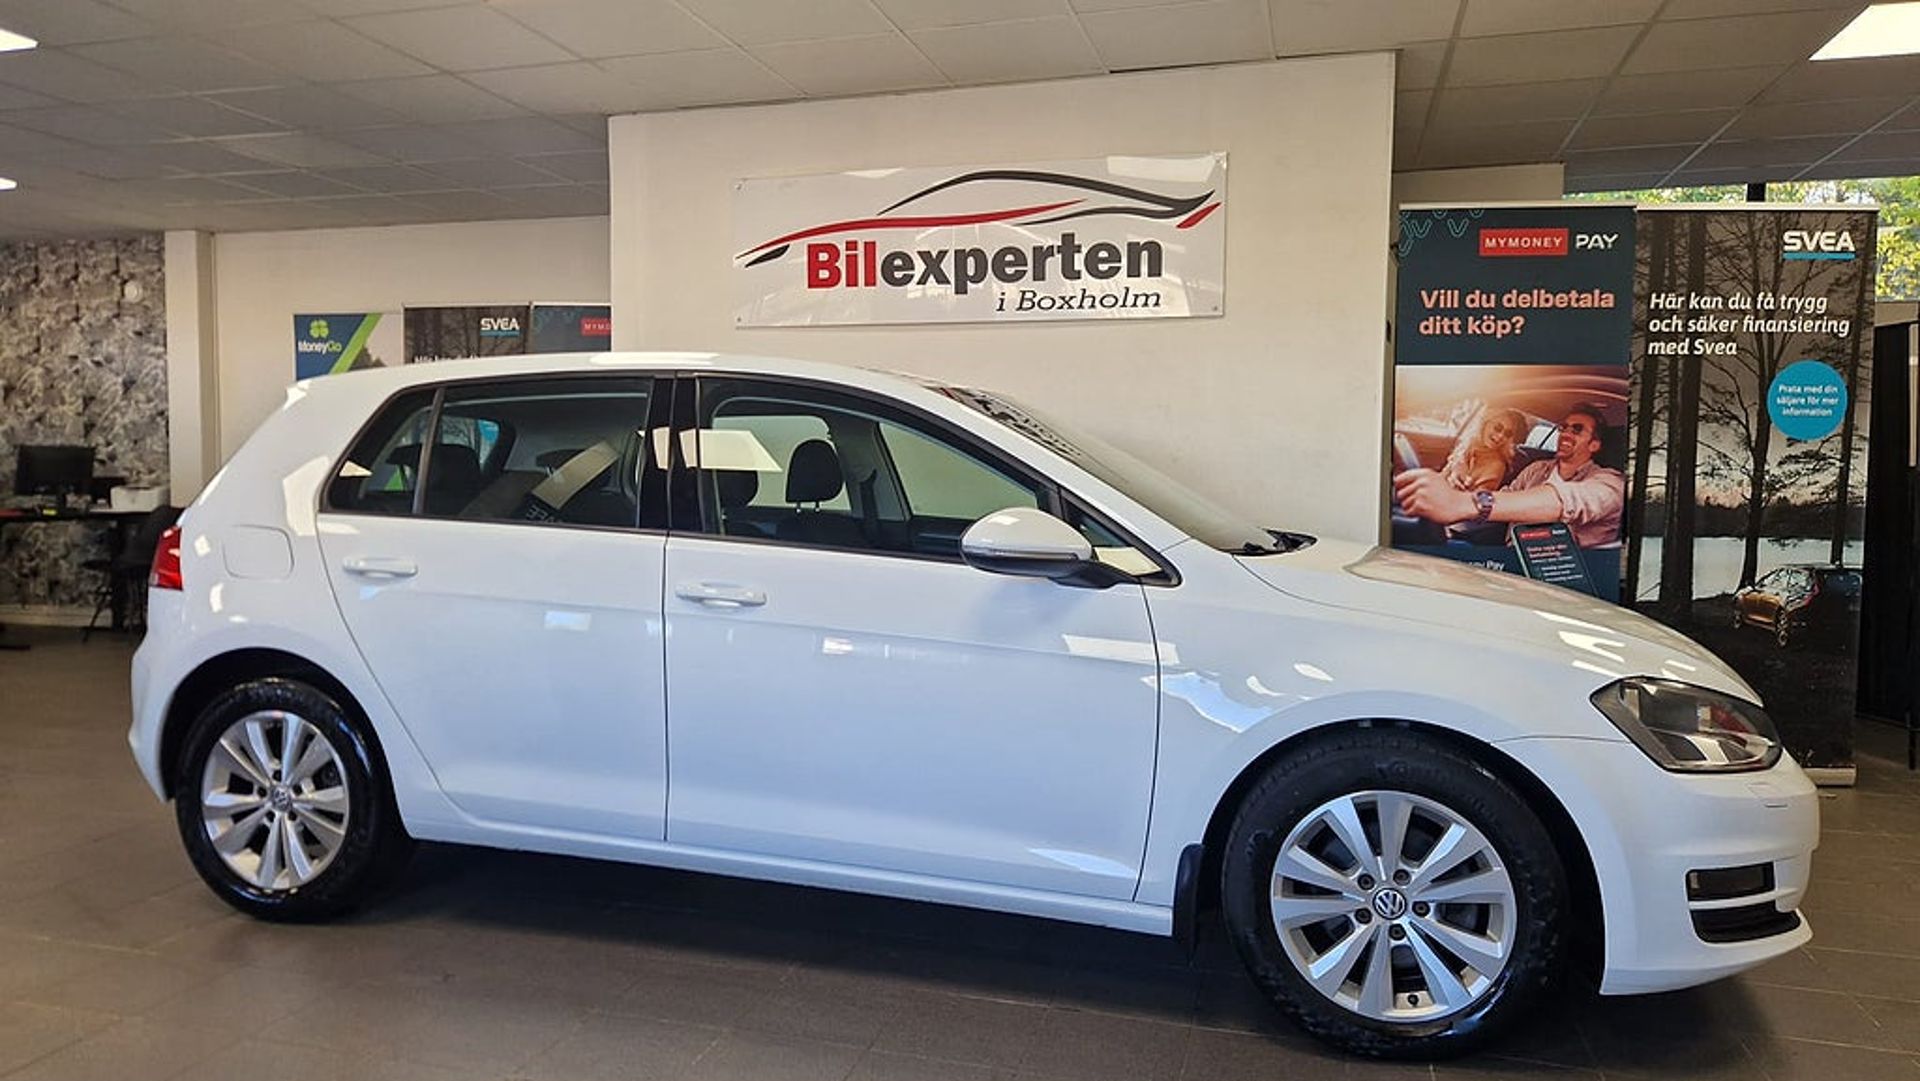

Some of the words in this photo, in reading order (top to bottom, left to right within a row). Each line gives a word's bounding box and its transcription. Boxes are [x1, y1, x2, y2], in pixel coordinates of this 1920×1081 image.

[1484, 236, 1563, 249] MYMONEY
[1575, 233, 1619, 250] PAY
[1782, 230, 1856, 252] SVEA
[807, 232, 1163, 295] Bilexperten
[996, 292, 1007, 312] i
[1016, 287, 1162, 312] Boxholm
[1420, 289, 1460, 309] Vill
[1465, 289, 1496, 309] du
[1502, 289, 1615, 309] delbetala
[1650, 292, 1685, 310] Här
[1688, 292, 1723, 310] kan
[1727, 292, 1751, 310] du
[1755, 292, 1776, 310] få
[1779, 294, 1828, 314] trygg
[480, 317, 520, 331] SVEA
[1419, 315, 1462, 335] ditt
[1467, 315, 1526, 339] köp?
[1649, 315, 1684, 333] och
[1687, 315, 1739, 333] säker
[1743, 316, 1851, 337] finansiering
[298, 340, 342, 354] MoneyGo
[1648, 338, 1690, 355] med
[1693, 339, 1738, 355] Svea
[1803, 384, 1823, 394] med
